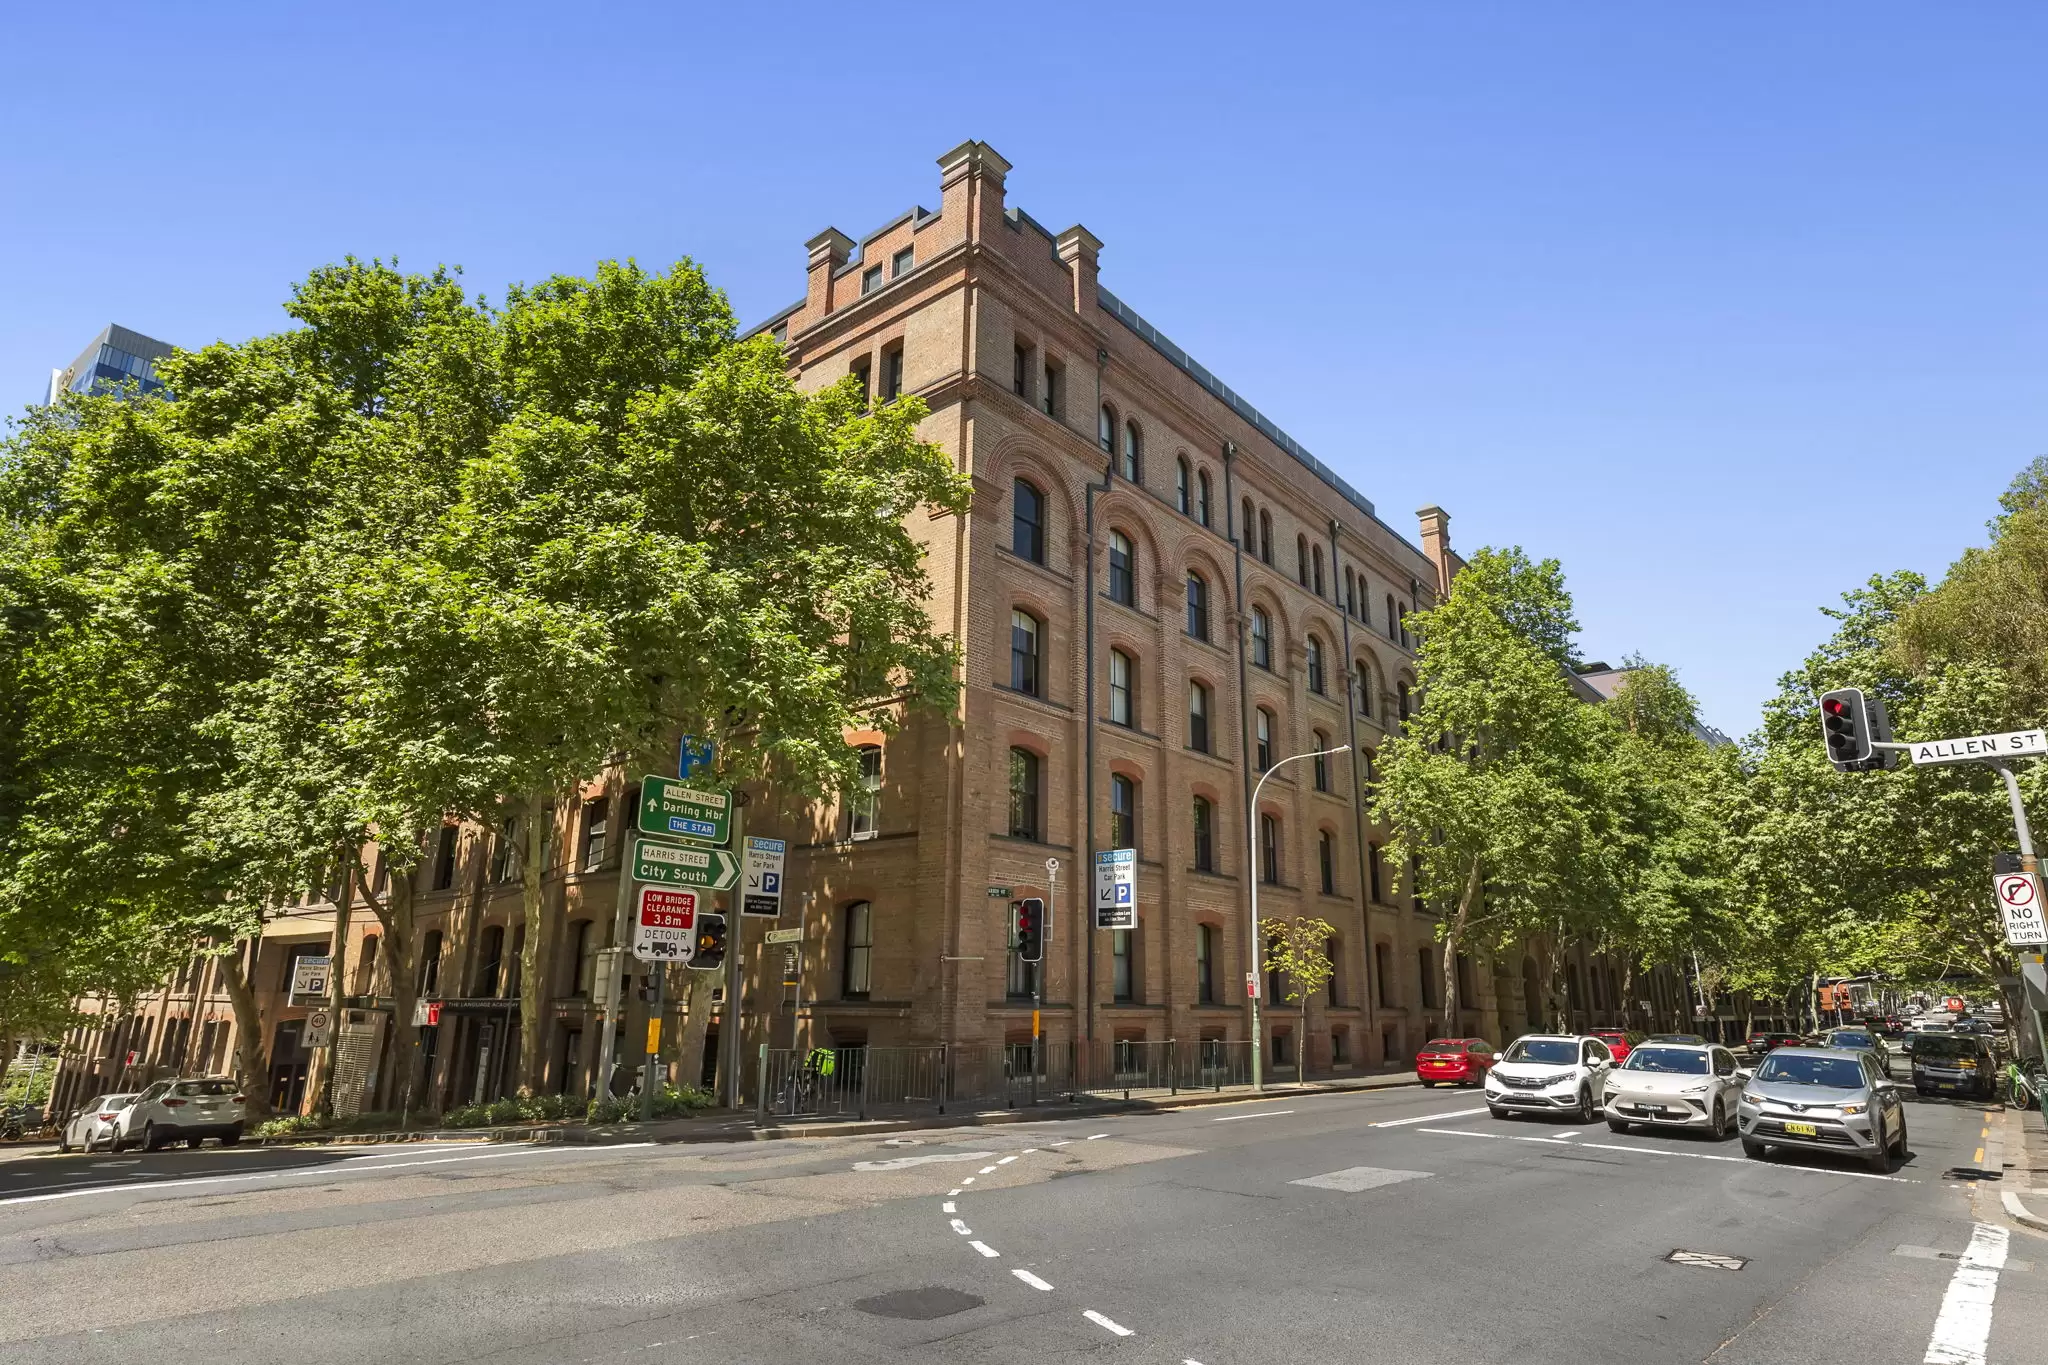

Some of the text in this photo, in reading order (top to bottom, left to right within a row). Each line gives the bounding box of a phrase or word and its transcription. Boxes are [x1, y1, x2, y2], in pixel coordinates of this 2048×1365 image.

[1919, 734, 2037, 759] ALLEN ST
[666, 788, 724, 805] ALLEN STREET
[663, 801, 723, 820] Darling Hbr
[672, 820, 712, 833] THE STAR
[754, 840, 782, 851] secure
[643, 848, 708, 865] HARRIS STREET
[1102, 851, 1131, 862] secure
[641, 864, 707, 882] City South
[765, 875, 776, 890] P
[647, 893, 692, 906] LOW BRIDGE
[1118, 886, 1127, 901] P
[646, 903, 691, 915] CLEARANCE
[2011, 908, 2033, 919] NO
[653, 914, 682, 926] 3.8m
[2009, 920, 2040, 930] RIGHT
[644, 929, 687, 940] DETOUR
[2013, 931, 2042, 940] TURN
[312, 980, 320, 990] P
